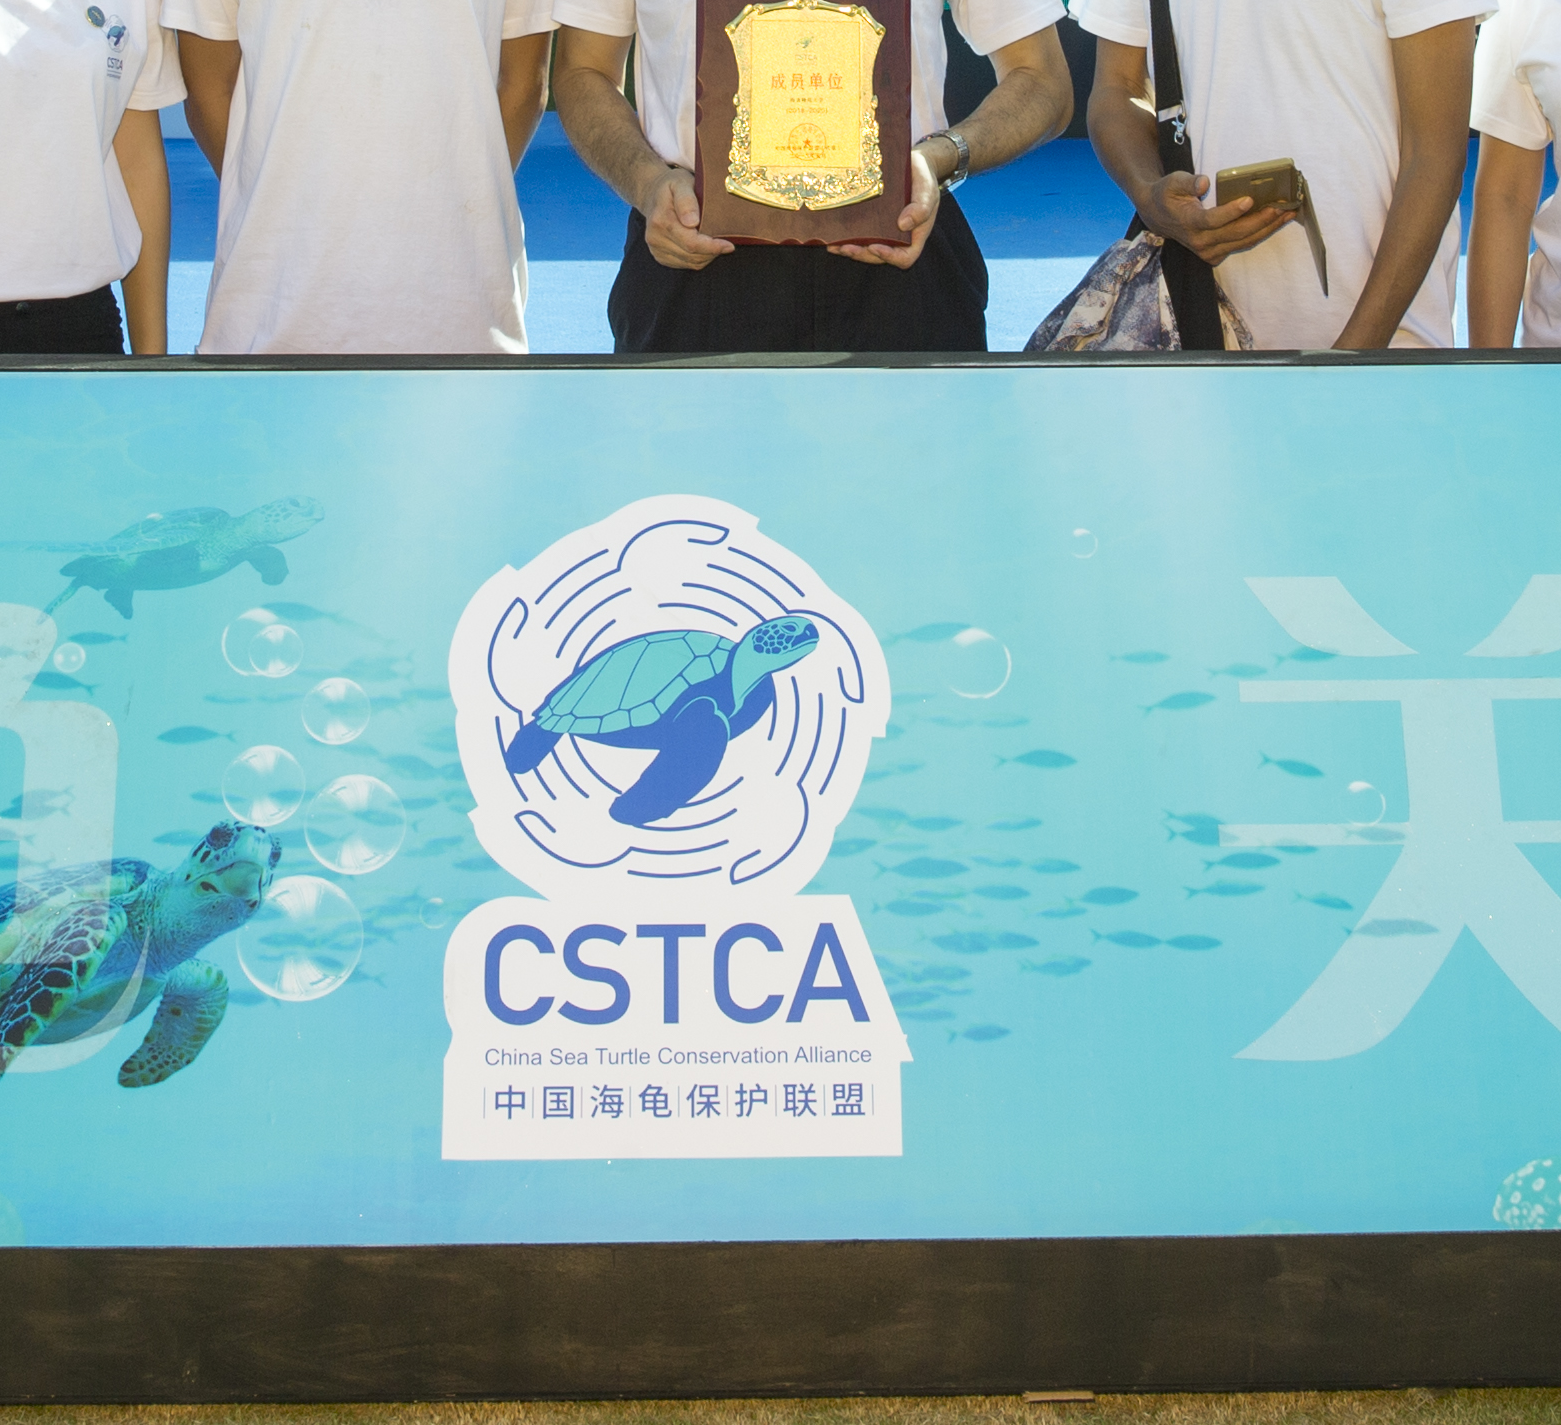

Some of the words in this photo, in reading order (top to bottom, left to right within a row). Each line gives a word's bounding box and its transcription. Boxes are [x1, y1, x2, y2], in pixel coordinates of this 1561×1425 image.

[771, 72, 844, 91] 成员单位
[484, 922, 871, 1026] CSTCA
[484, 1048, 543, 1067] China
[549, 1047, 589, 1066] Sea
[595, 1047, 651, 1066] Turtle
[657, 1046, 789, 1065] Conservation
[794, 1045, 872, 1064] Alliance
[494, 1083, 866, 1120] 中国海龟保护联盟
